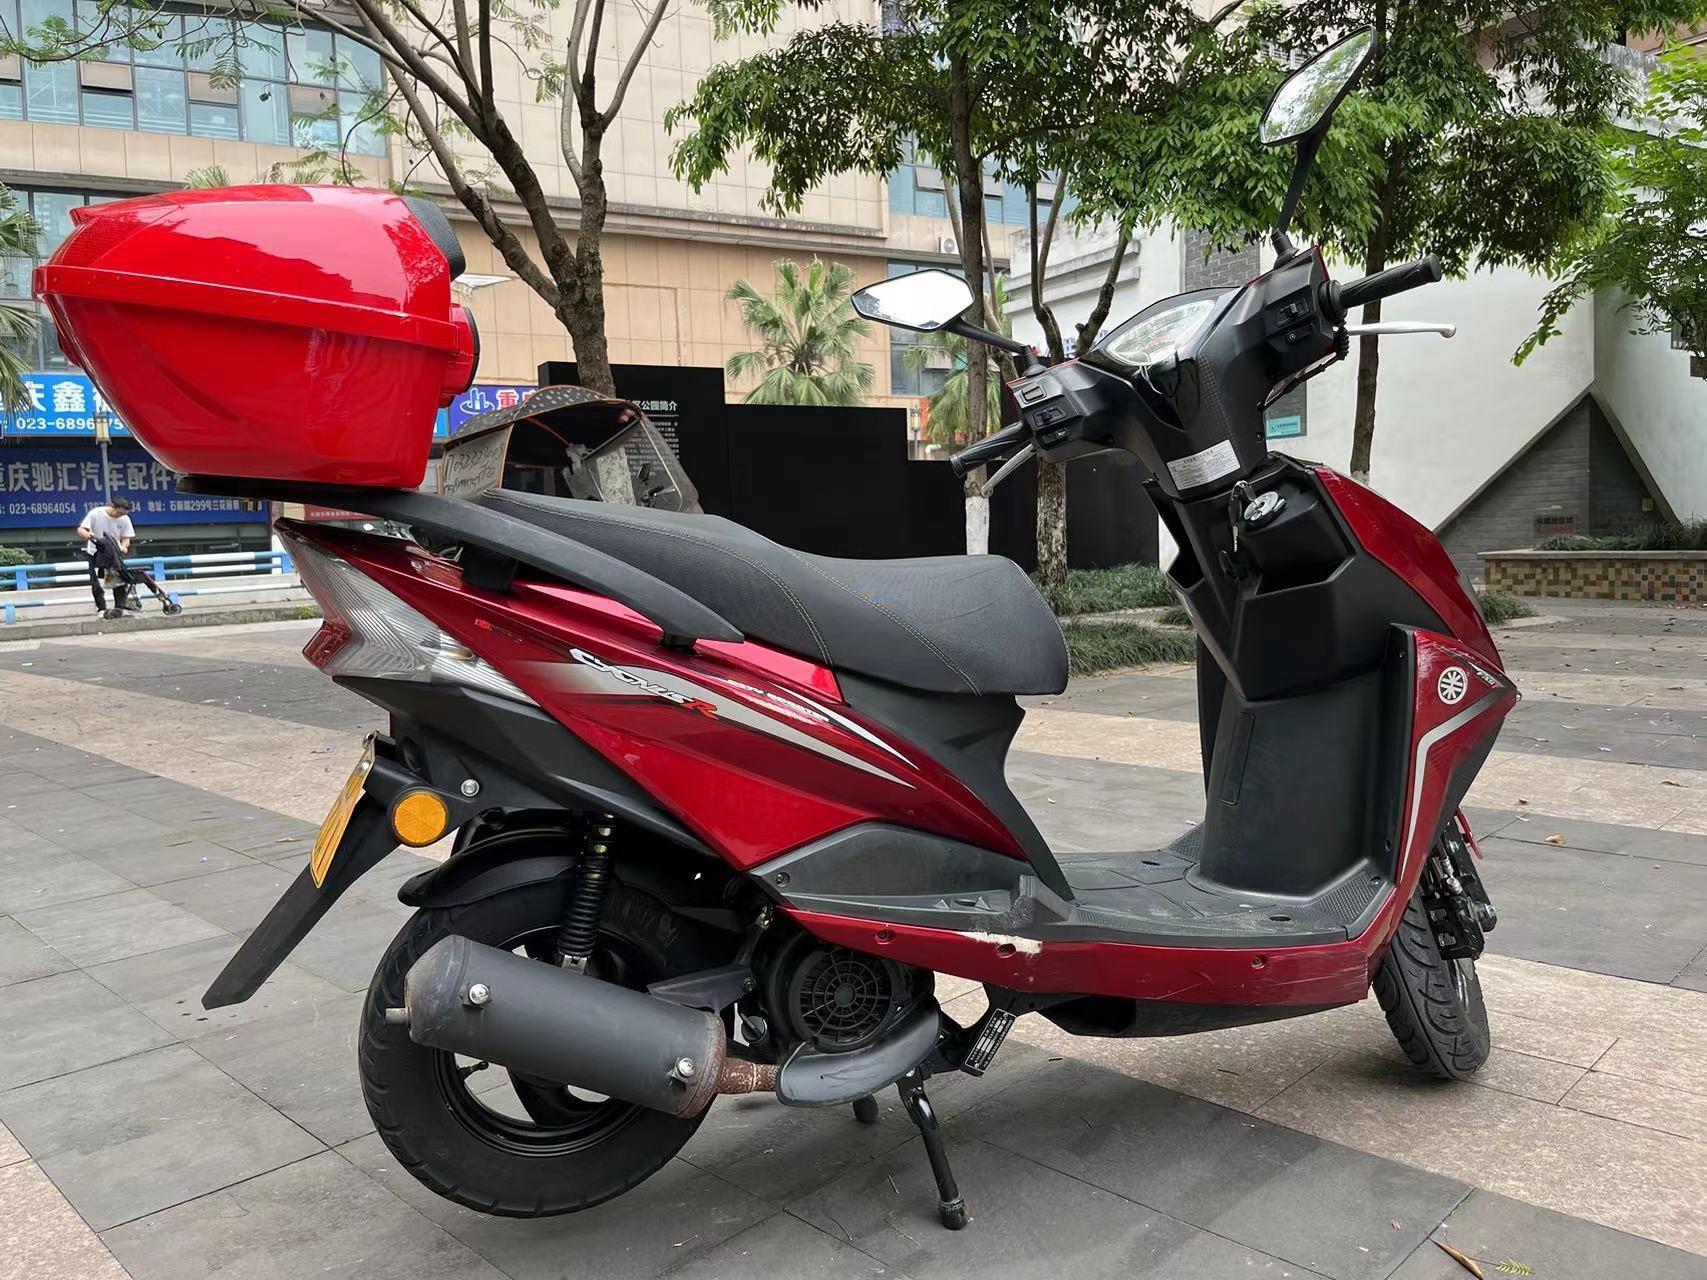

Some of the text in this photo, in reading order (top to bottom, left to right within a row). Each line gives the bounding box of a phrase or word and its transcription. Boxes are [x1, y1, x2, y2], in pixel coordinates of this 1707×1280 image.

[0, 381, 113, 413] 庆鑫
[17, 418, 124, 430] 023-689675
[0, 461, 187, 493] 庆驰汇汽车配件
[9, 502, 76, 514] 023-68964054
